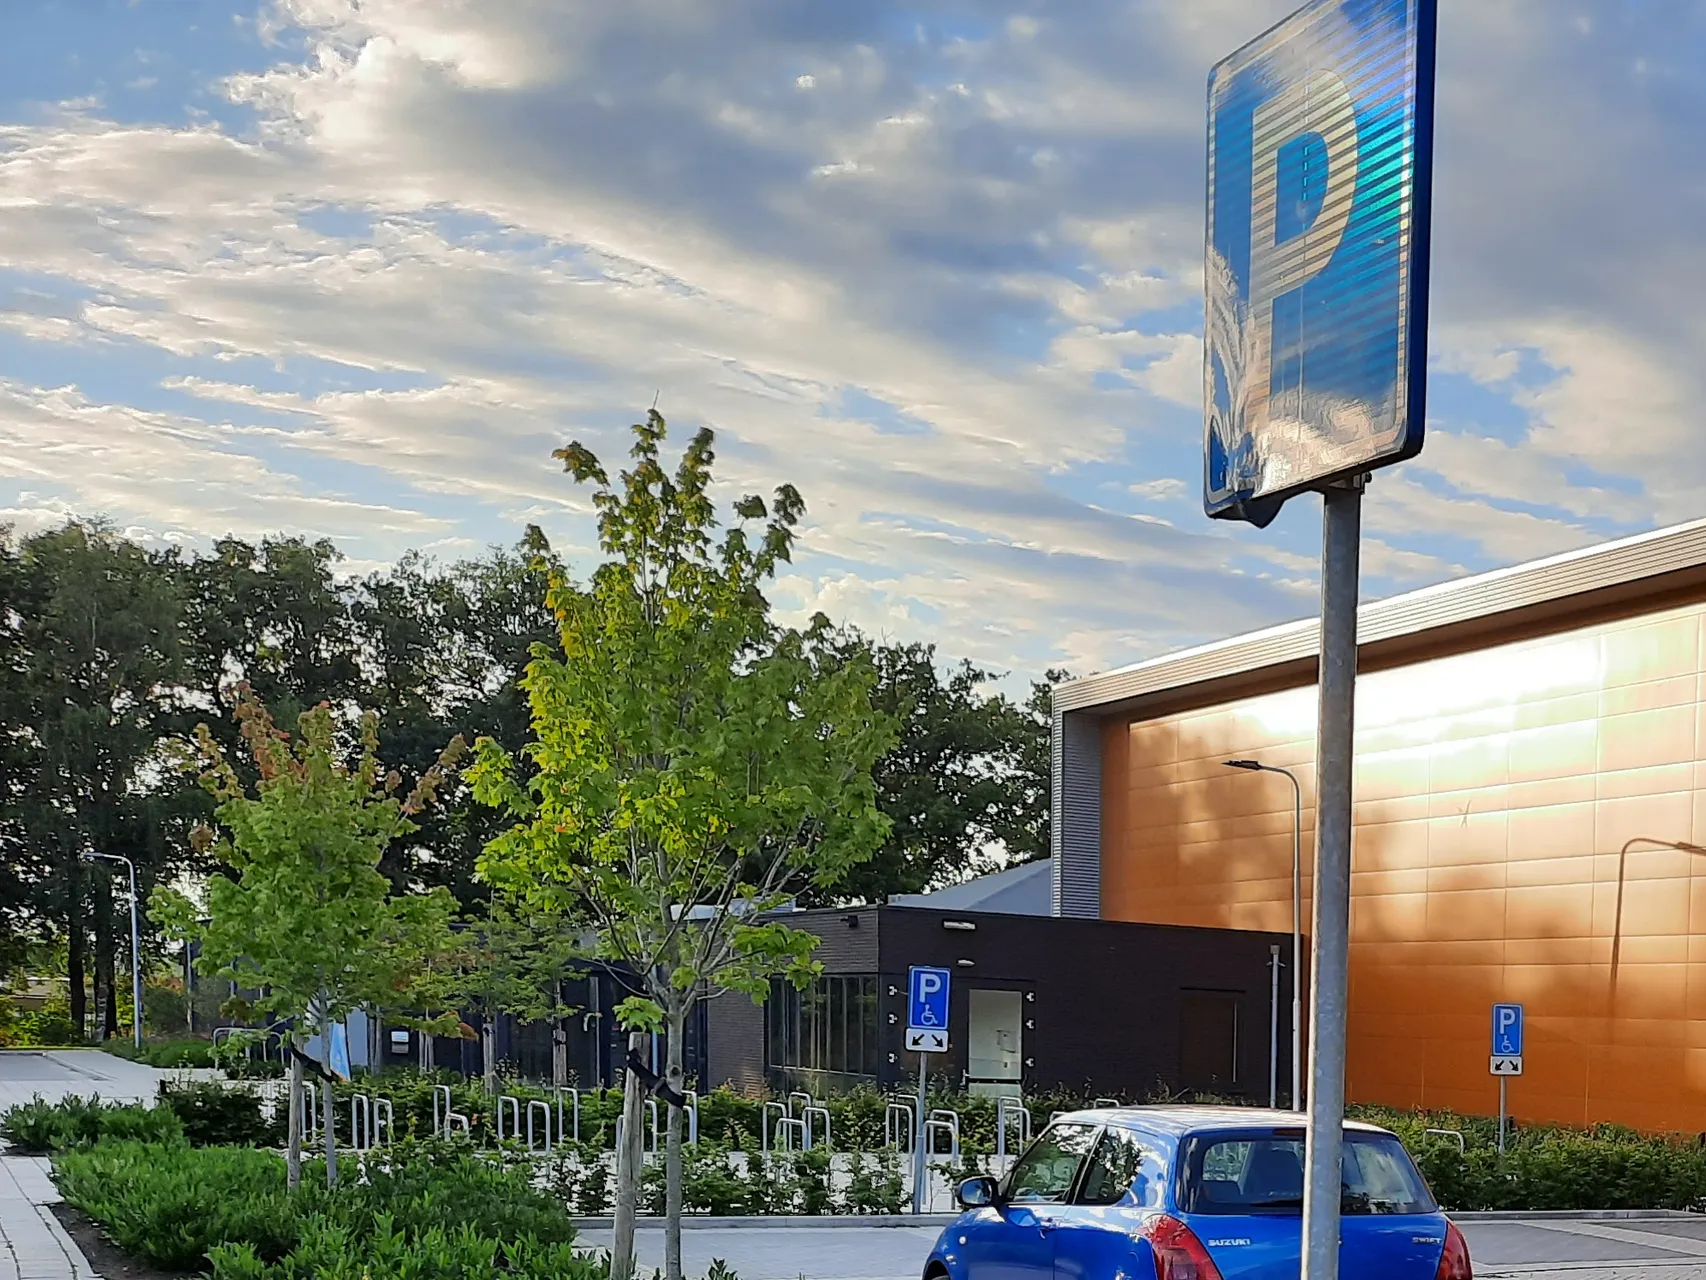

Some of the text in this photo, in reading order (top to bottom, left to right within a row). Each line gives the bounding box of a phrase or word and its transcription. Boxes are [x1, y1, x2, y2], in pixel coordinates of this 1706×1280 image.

[1246, 68, 1359, 430] P
[919, 973, 941, 1003] P
[1500, 1008, 1516, 1034] P
[1207, 1238, 1251, 1247] SUZUKI
